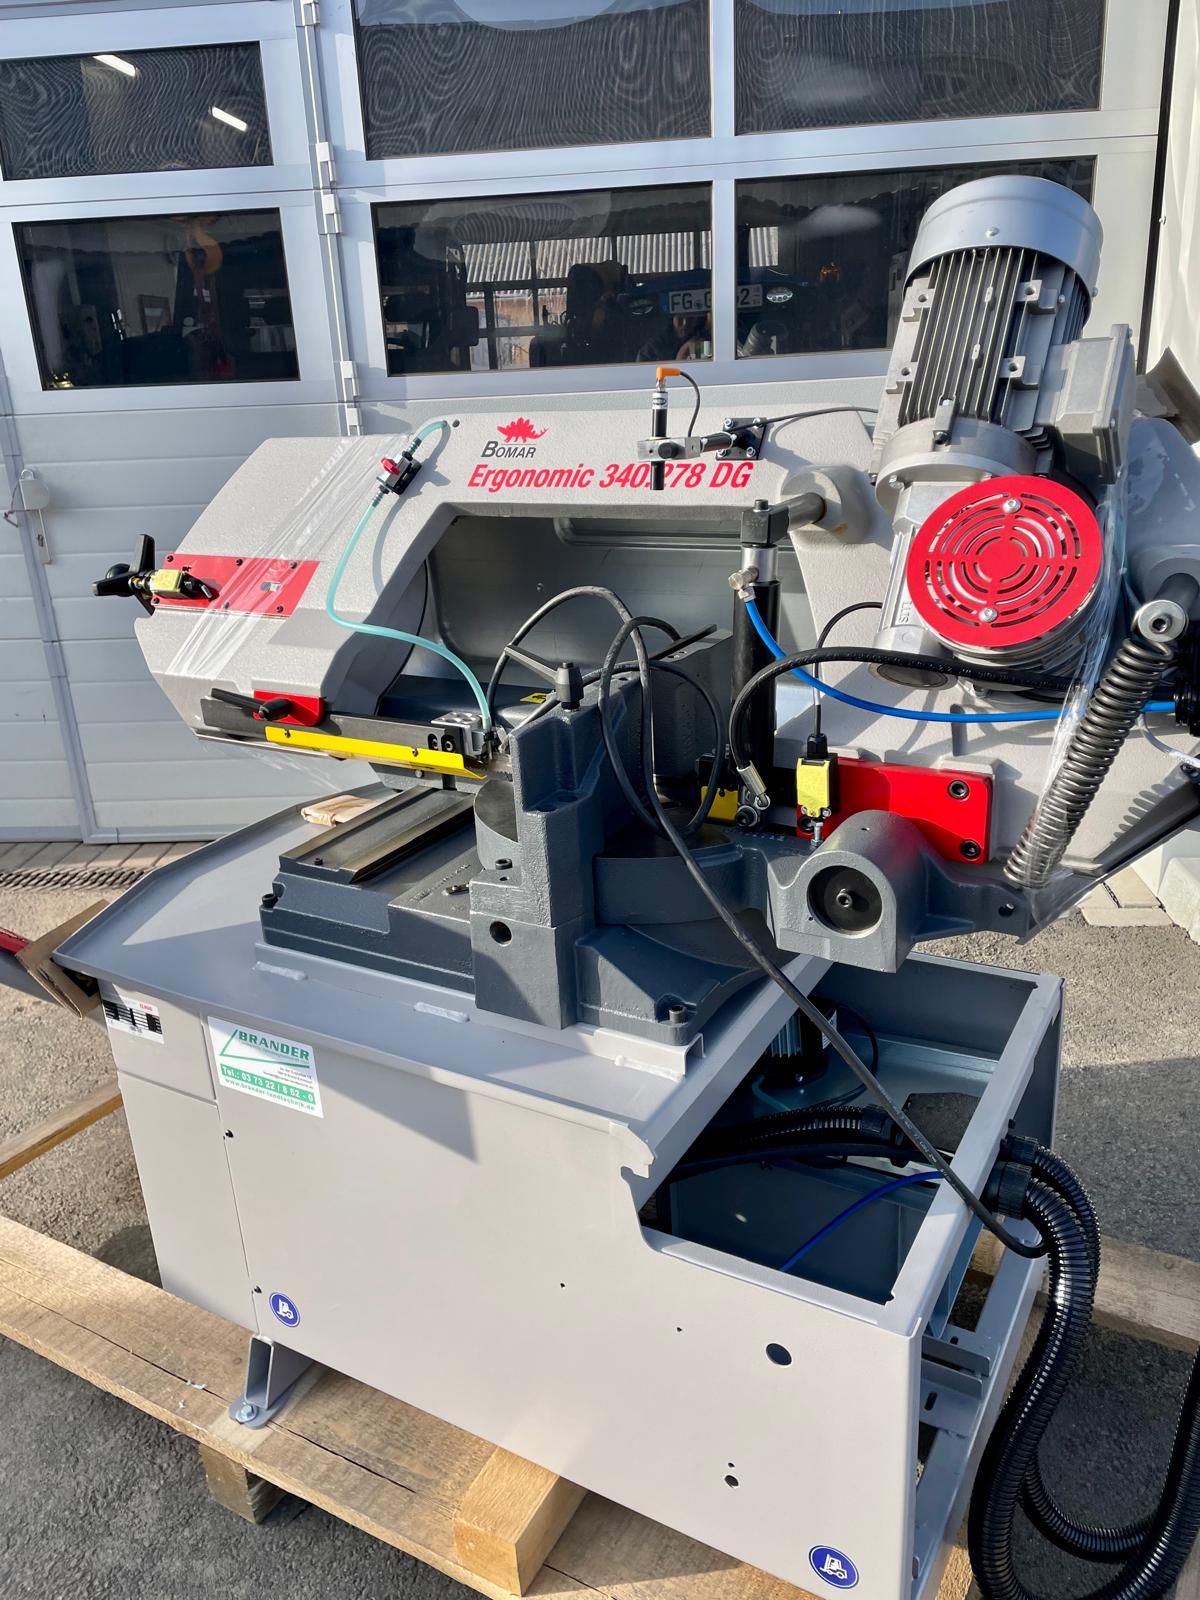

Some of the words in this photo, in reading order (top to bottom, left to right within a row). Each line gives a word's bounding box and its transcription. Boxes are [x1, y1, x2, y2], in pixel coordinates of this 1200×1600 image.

[671, 292, 693, 312] FG
[480, 440, 537, 459] BOMAR
[467, 463, 595, 493] Ergonomic
[709, 461, 754, 489] DG
[238, 1031, 310, 1061] BRANDER
[222, 1066, 241, 1079] Tel.:
[241, 1072, 252, 1082] 03
[253, 1076, 264, 1086] 73
[264, 1080, 275, 1090] 22
[307, 1093, 314, 1103] 0
